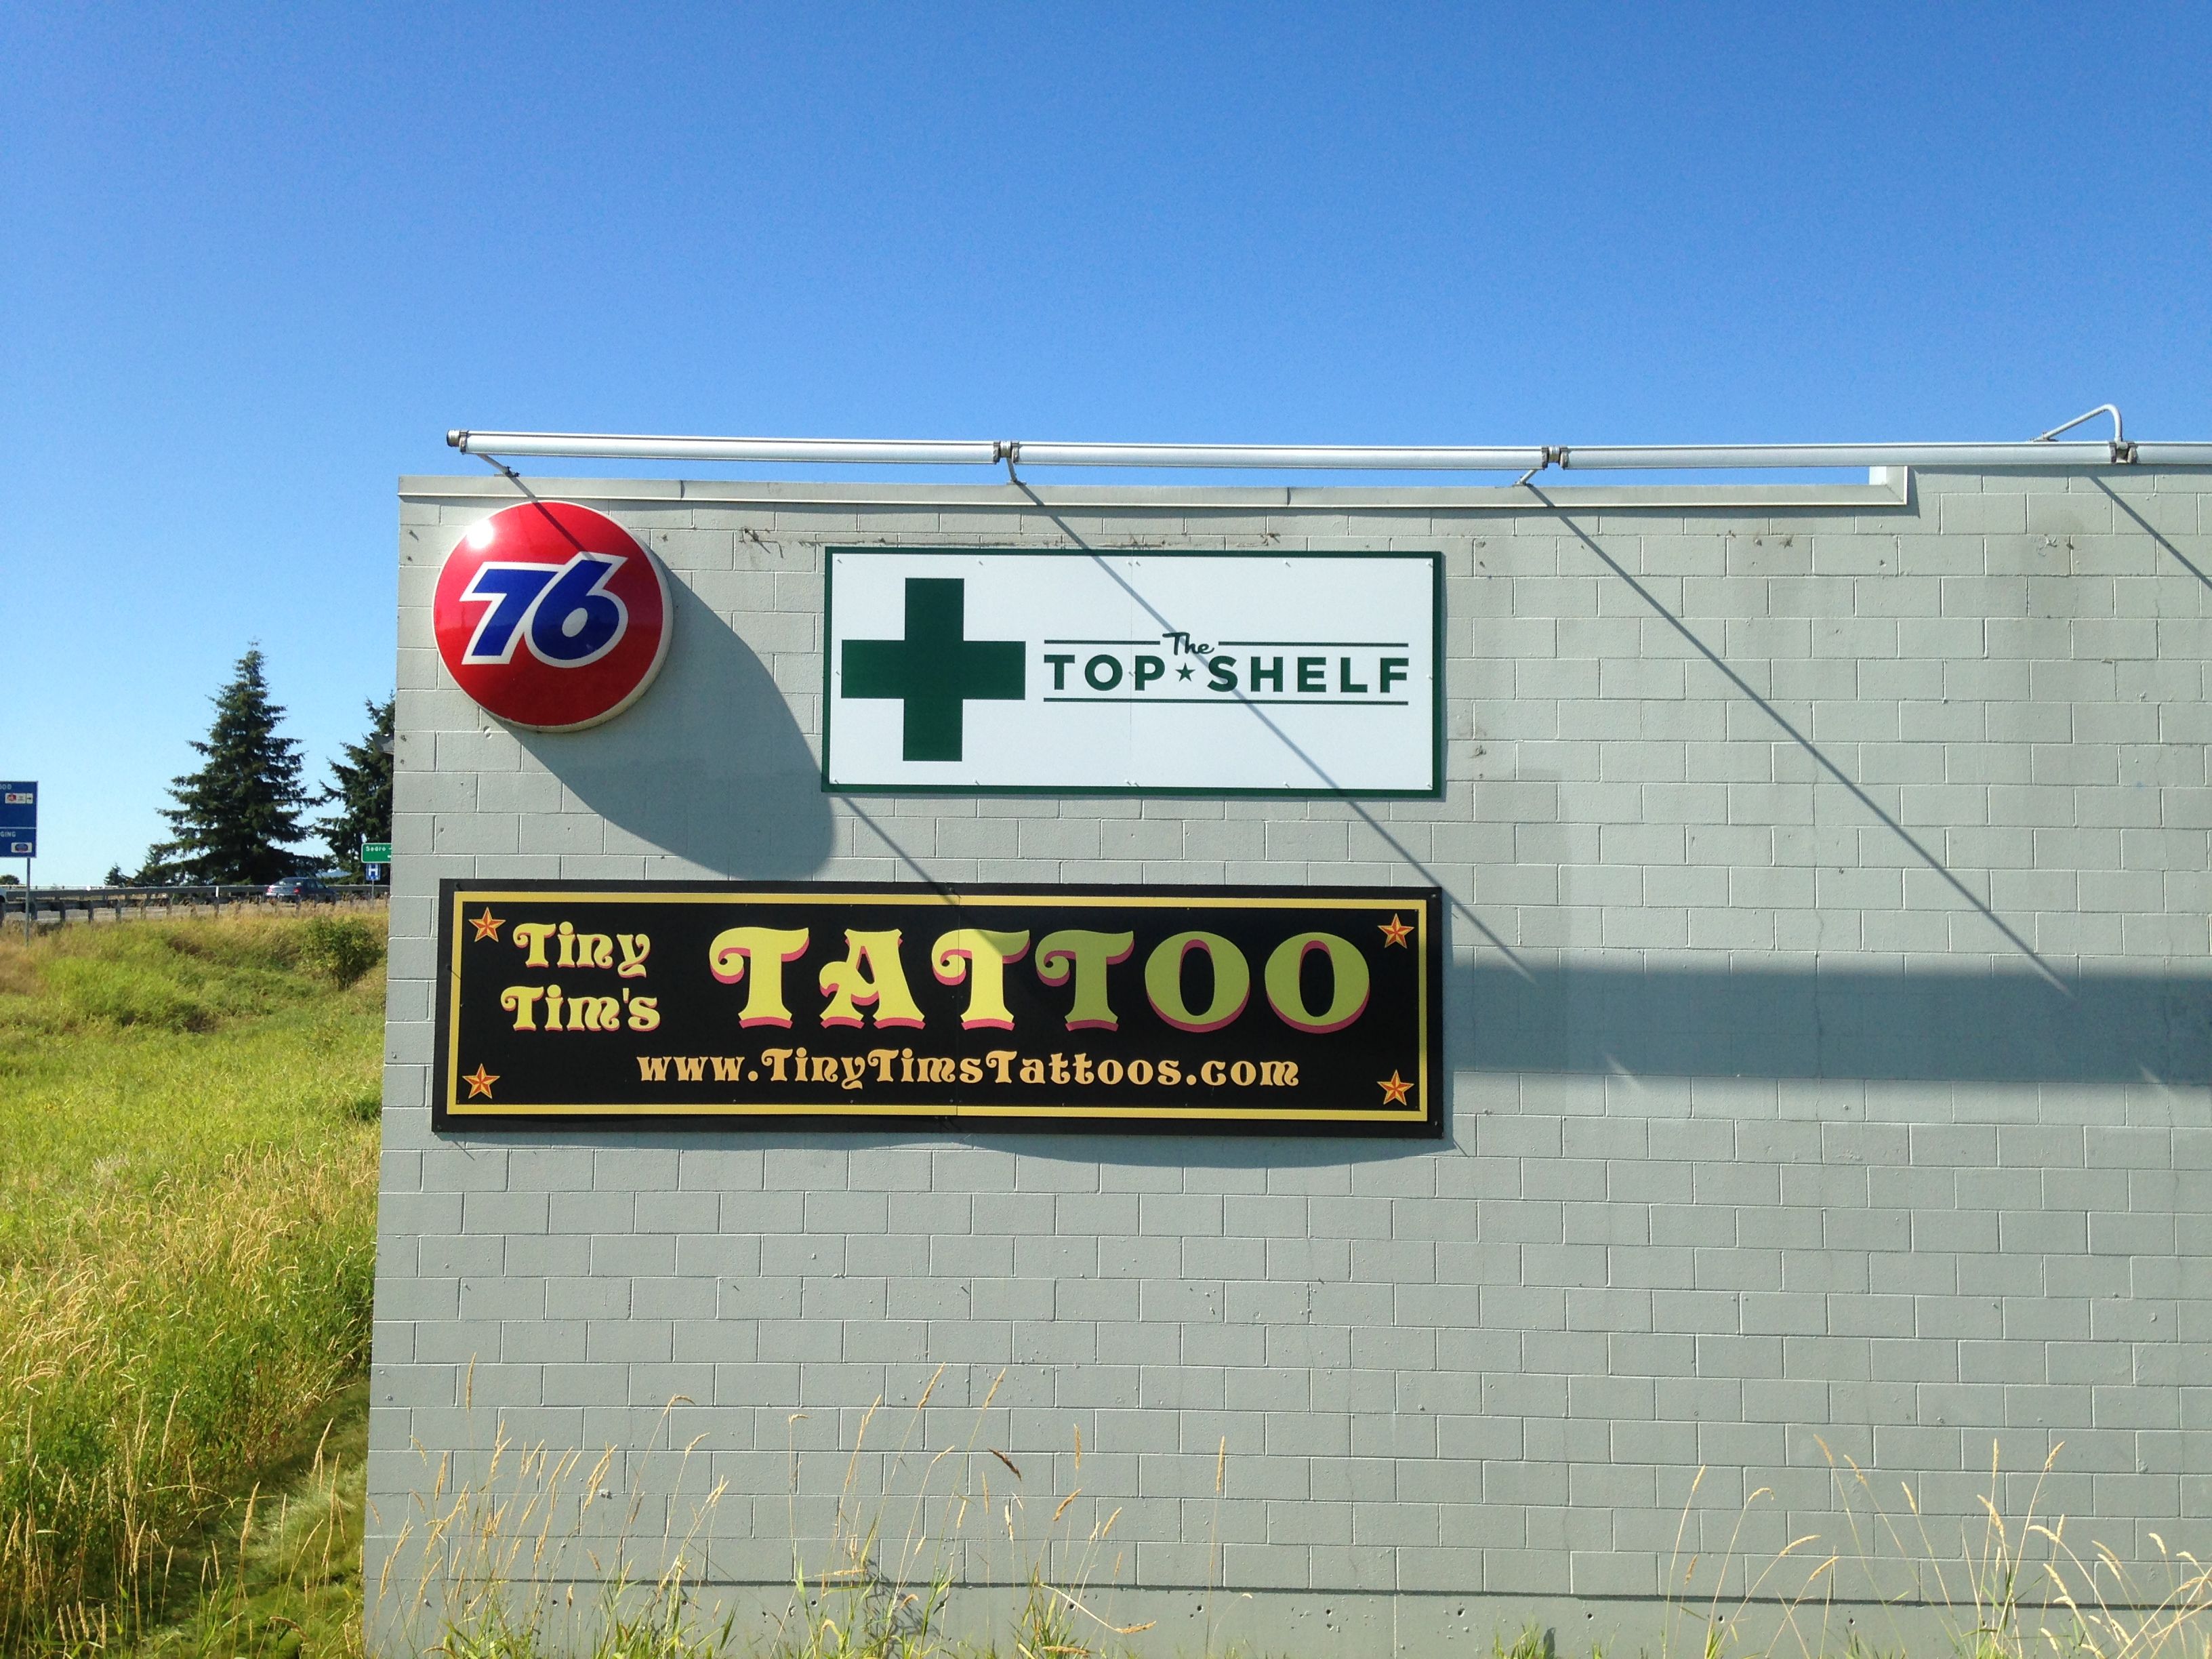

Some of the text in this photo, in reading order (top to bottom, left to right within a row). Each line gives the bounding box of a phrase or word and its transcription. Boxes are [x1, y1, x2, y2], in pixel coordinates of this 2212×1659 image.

[459, 551, 629, 668] 76
[1162, 632, 1215, 655] The
[1044, 654, 1409, 693] TOP SHELF
[513, 921, 651, 978] Tiny
[709, 926, 1370, 1034] TATTOO
[500, 984, 661, 1031] Tim's
[636, 1047, 1299, 1090] www.TinyTimsTattoos.com
